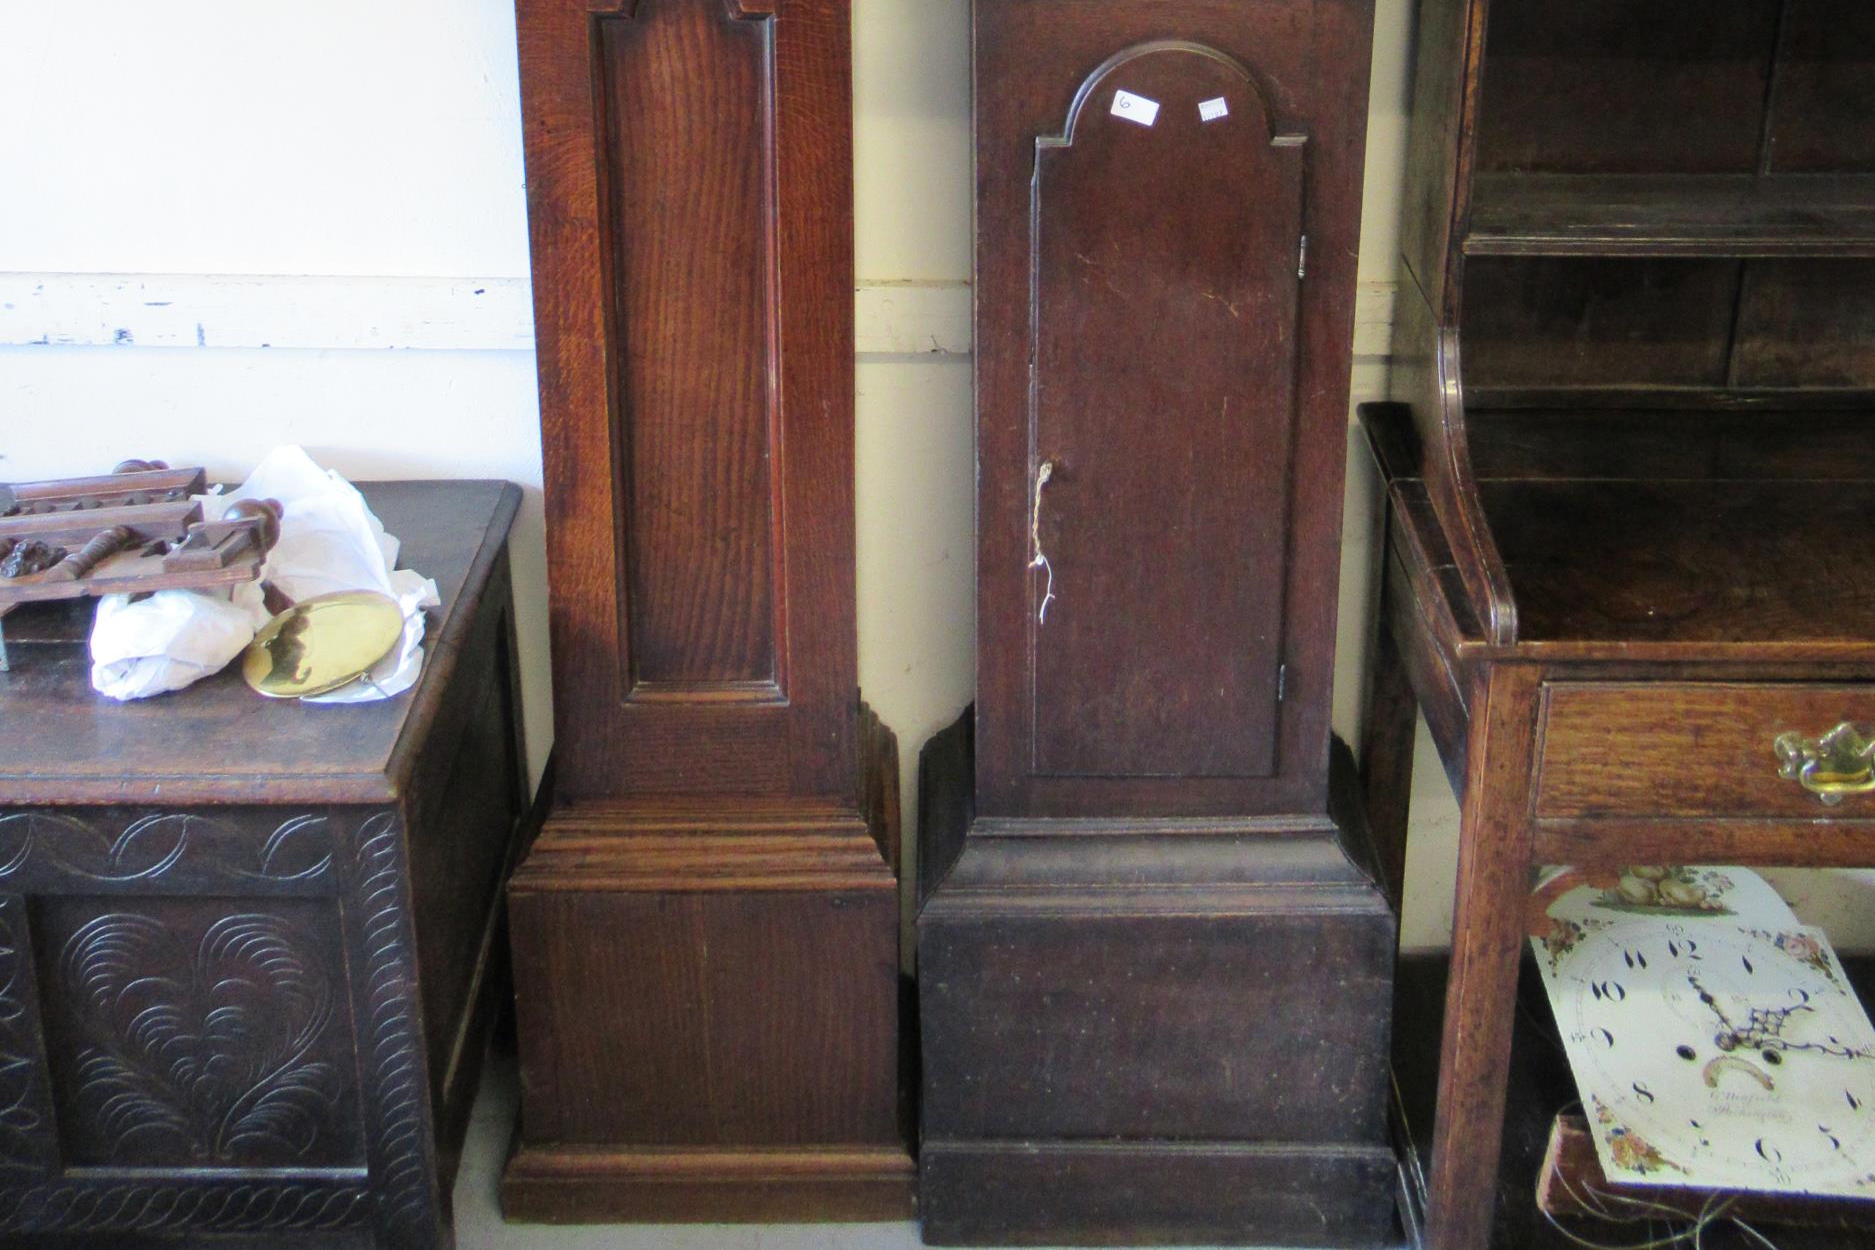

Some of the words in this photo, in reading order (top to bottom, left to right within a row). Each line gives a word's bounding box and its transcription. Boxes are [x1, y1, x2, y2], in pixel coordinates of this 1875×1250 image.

[1119, 95, 1131, 110] 6
[1624, 949, 1647, 969] 11
[1668, 940, 1702, 960] 12
[1592, 980, 1625, 1002] 10
[1590, 1027, 1614, 1048] 9
